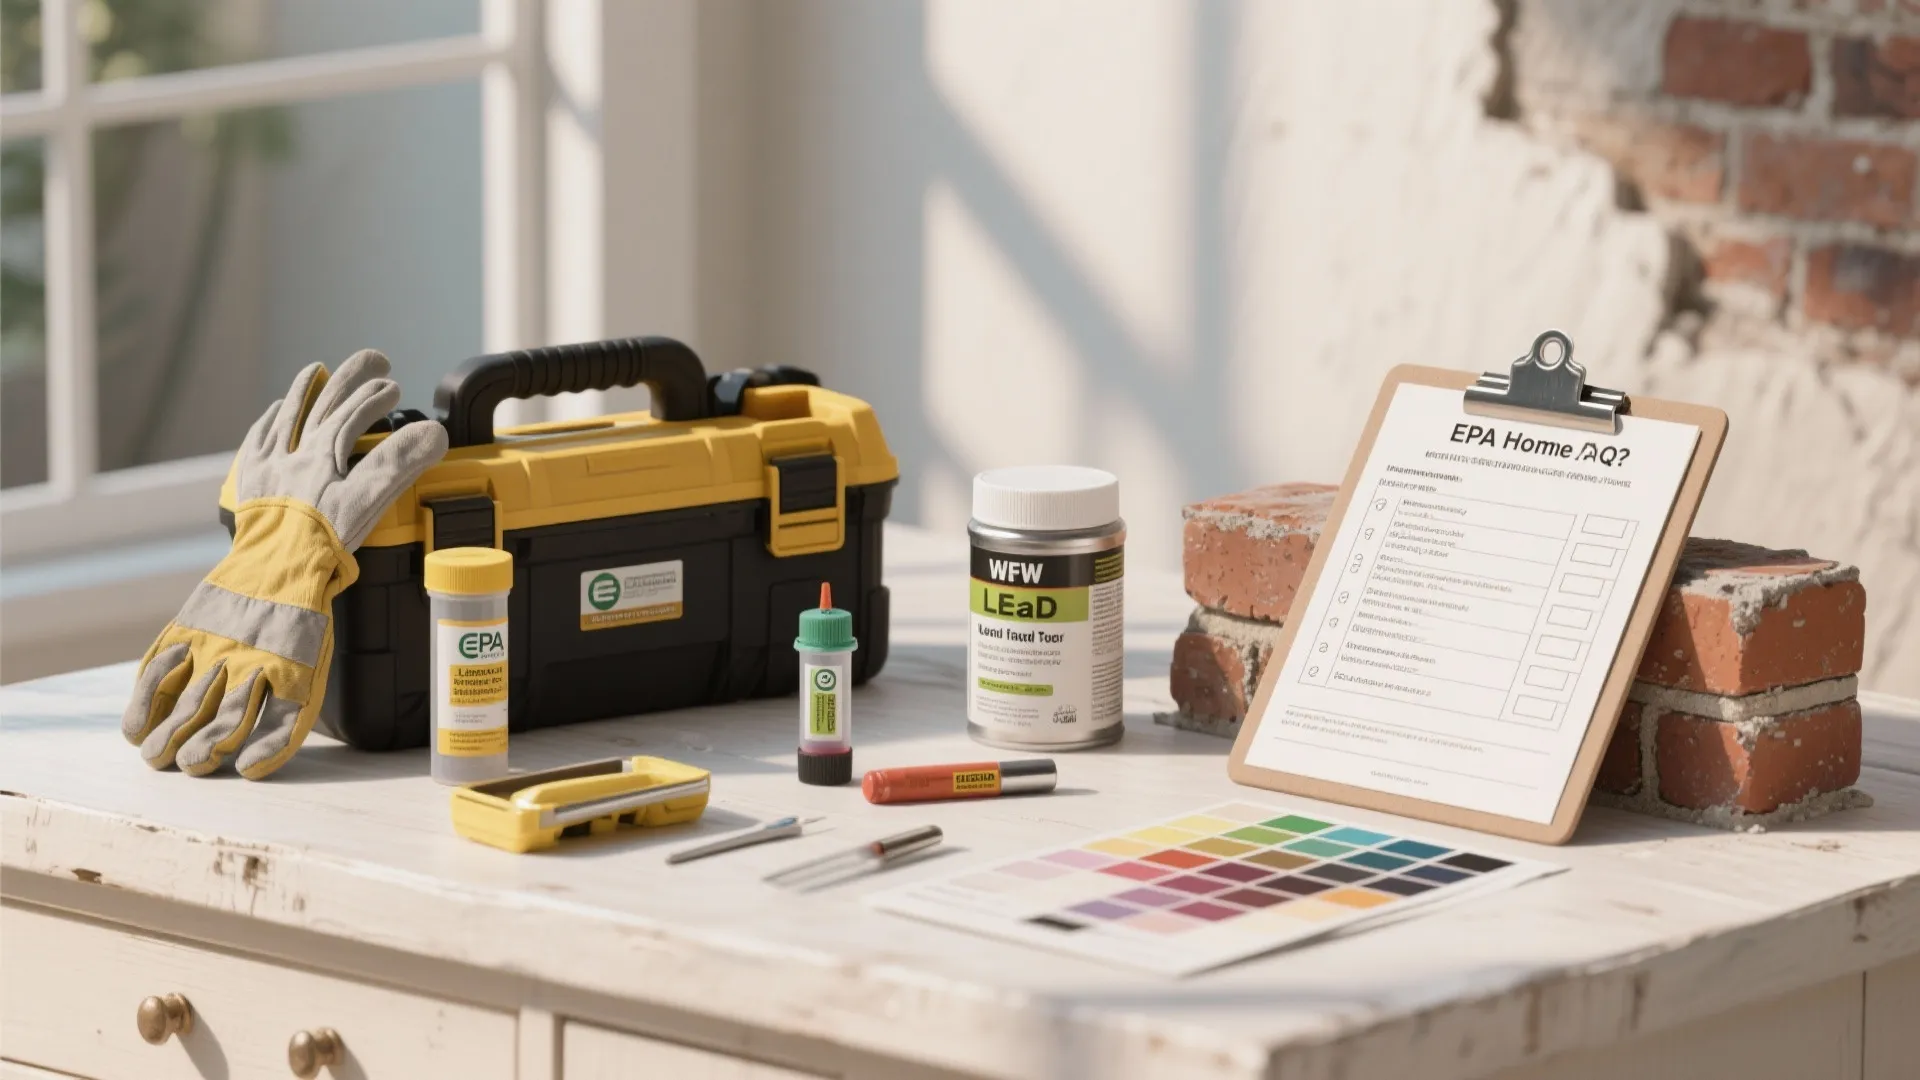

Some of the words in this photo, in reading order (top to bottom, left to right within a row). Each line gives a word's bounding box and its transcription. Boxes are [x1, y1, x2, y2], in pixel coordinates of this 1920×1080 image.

[1450, 423, 1495, 447] EPA
[1503, 431, 1573, 458] Home
[989, 558, 1043, 584] WFW
[983, 587, 1058, 619] LEaD
[458, 631, 504, 658] EPA
